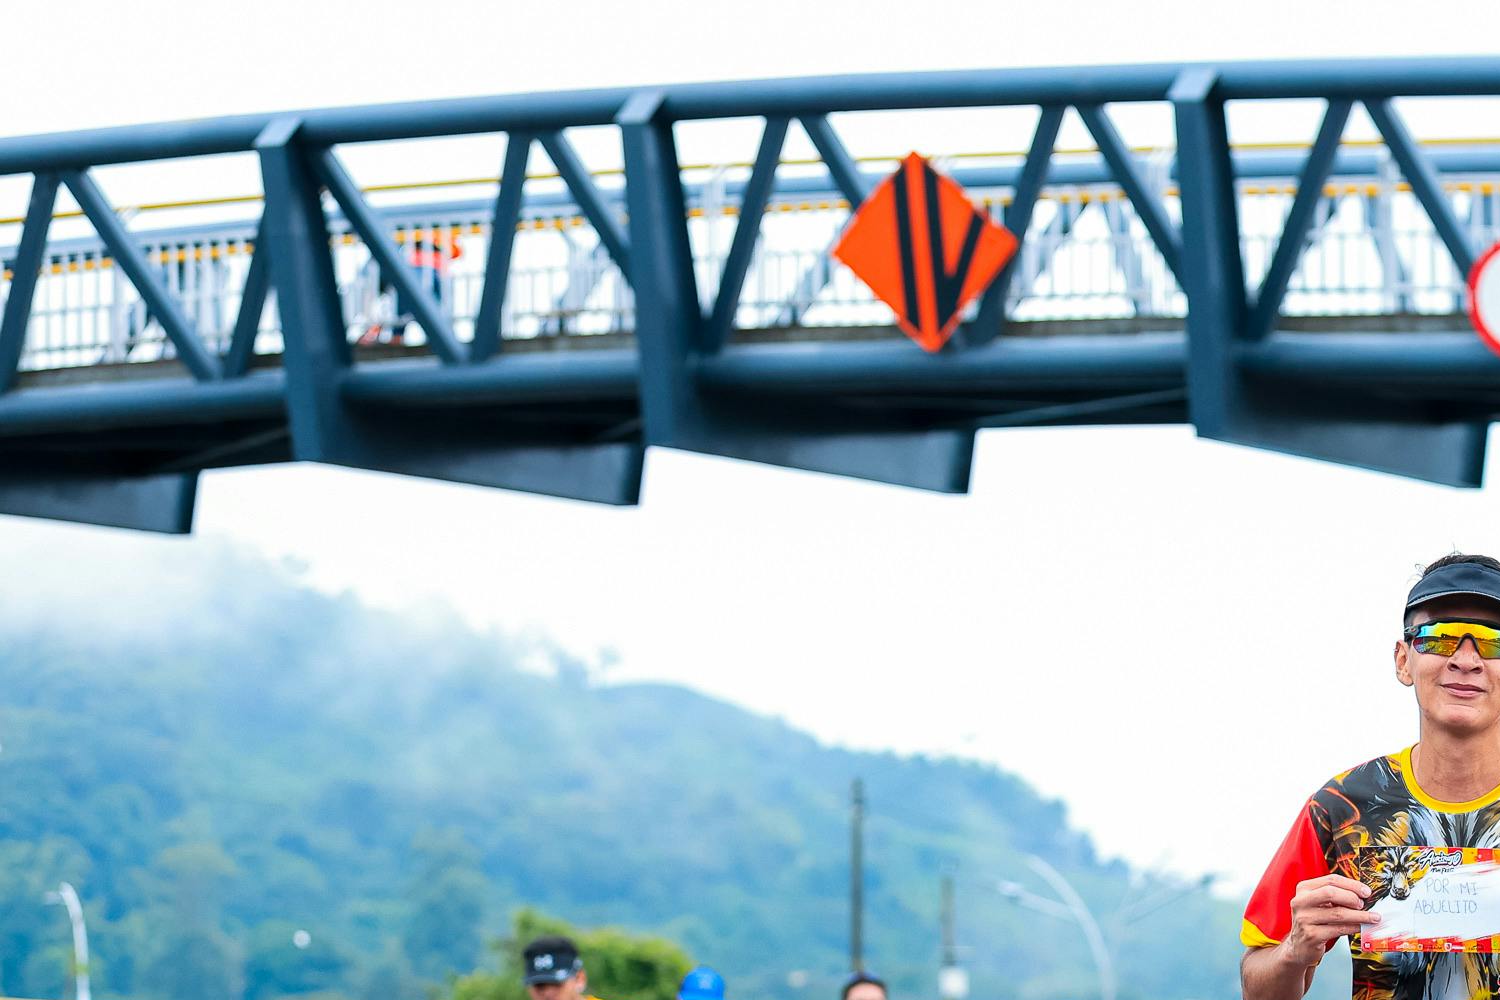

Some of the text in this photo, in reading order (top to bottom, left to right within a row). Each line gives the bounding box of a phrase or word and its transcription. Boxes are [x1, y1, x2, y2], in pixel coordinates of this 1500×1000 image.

[1425, 878, 1478, 896] POR MI
[1415, 899, 1478, 915] ABUELITO
